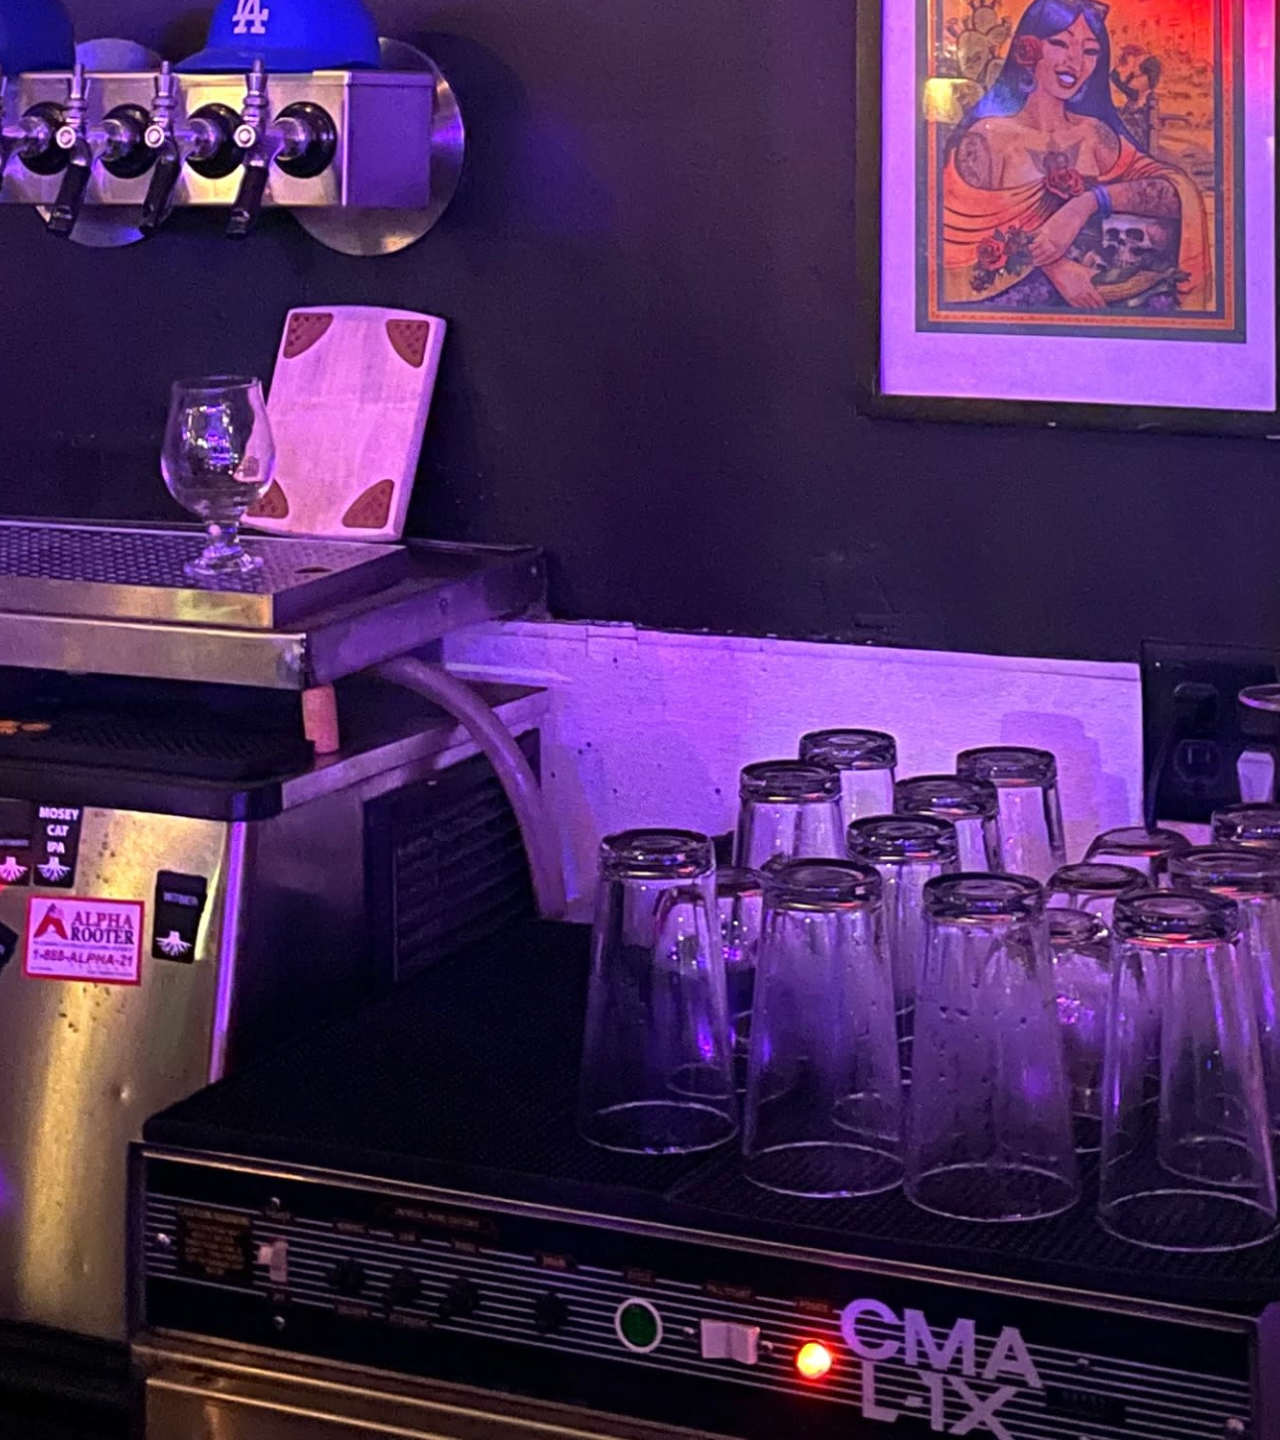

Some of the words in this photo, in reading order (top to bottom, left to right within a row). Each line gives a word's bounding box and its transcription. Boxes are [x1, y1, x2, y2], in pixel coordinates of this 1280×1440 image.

[38, 806, 80, 822] MOSEY
[46, 823, 70, 839] CAT
[46, 840, 66, 855] IPA
[72, 911, 134, 930] ALPHA
[71, 926, 135, 945] ROOTER
[840, 1296, 1044, 1389] CMA
